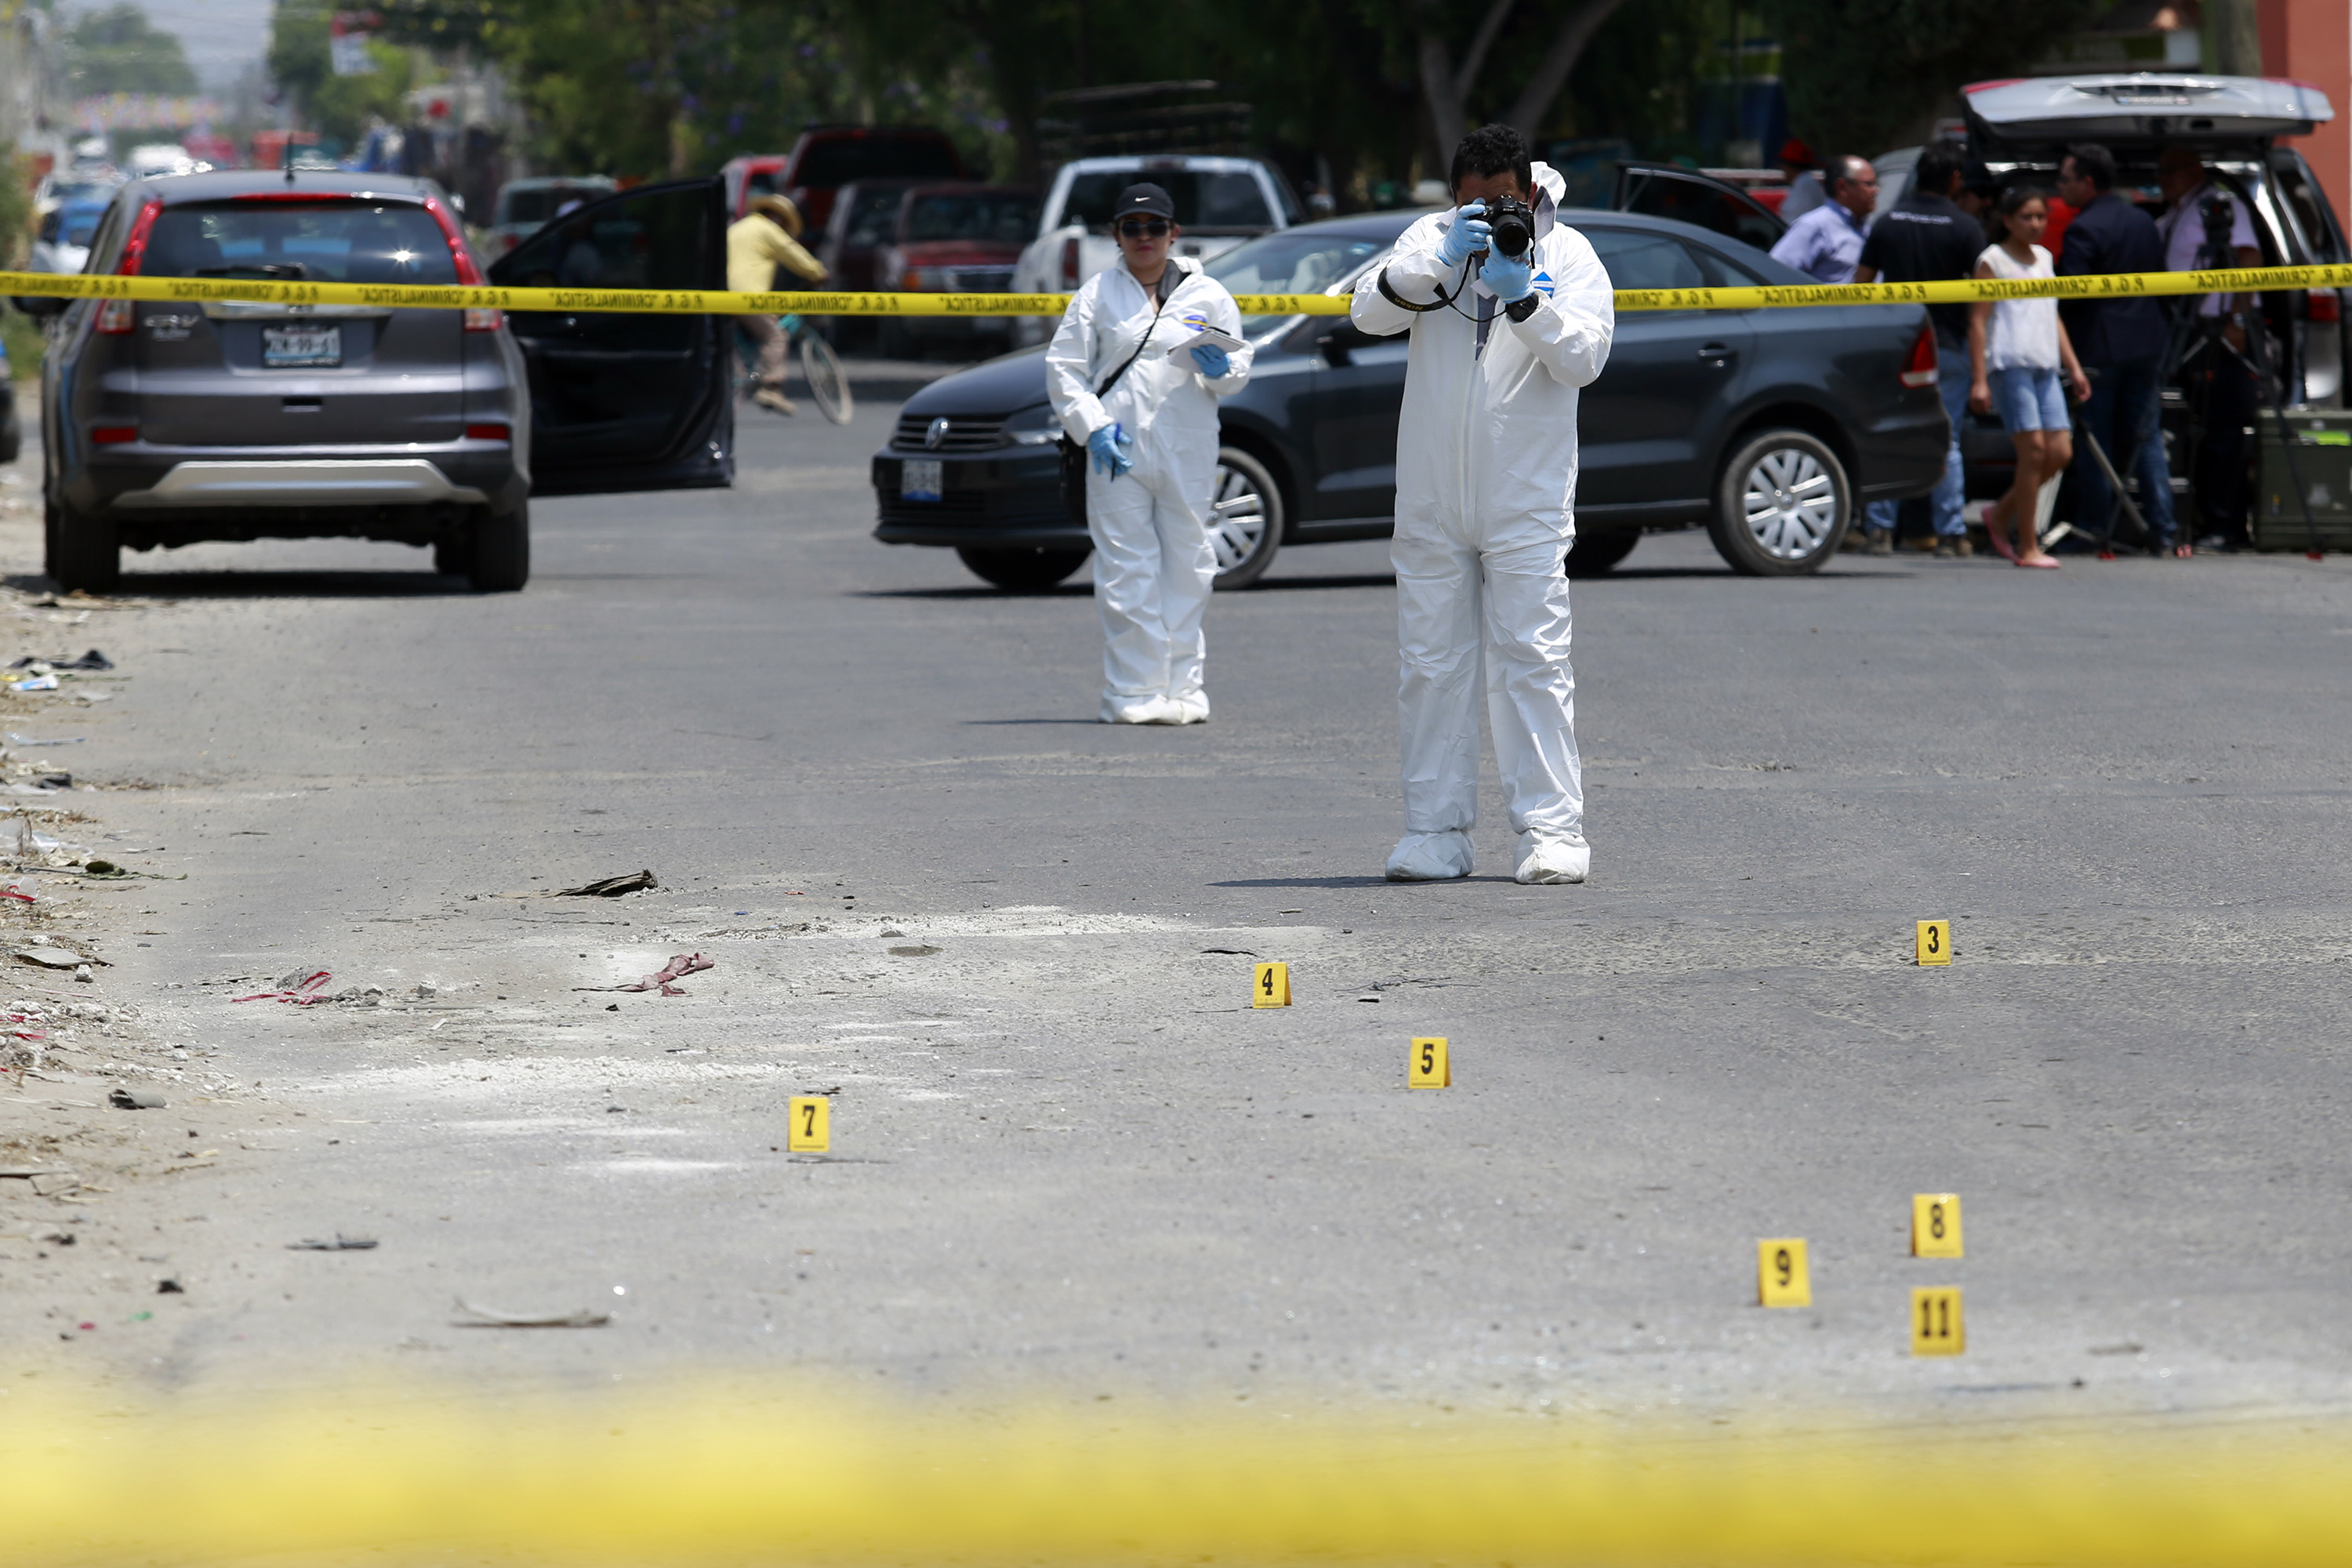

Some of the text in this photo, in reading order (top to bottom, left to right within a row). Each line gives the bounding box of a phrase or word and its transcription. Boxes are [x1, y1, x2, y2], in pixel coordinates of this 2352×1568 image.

[1395, 298, 1423, 310] Nikon
[1928, 925, 1939, 953] 3
[1262, 968, 1273, 996] 4
[1421, 1044, 1434, 1074] 5
[803, 1105, 815, 1137] 7
[1930, 1203, 1946, 1239] 8
[1776, 1248, 1792, 1287] 9
[1921, 1298, 1950, 1338] 11
